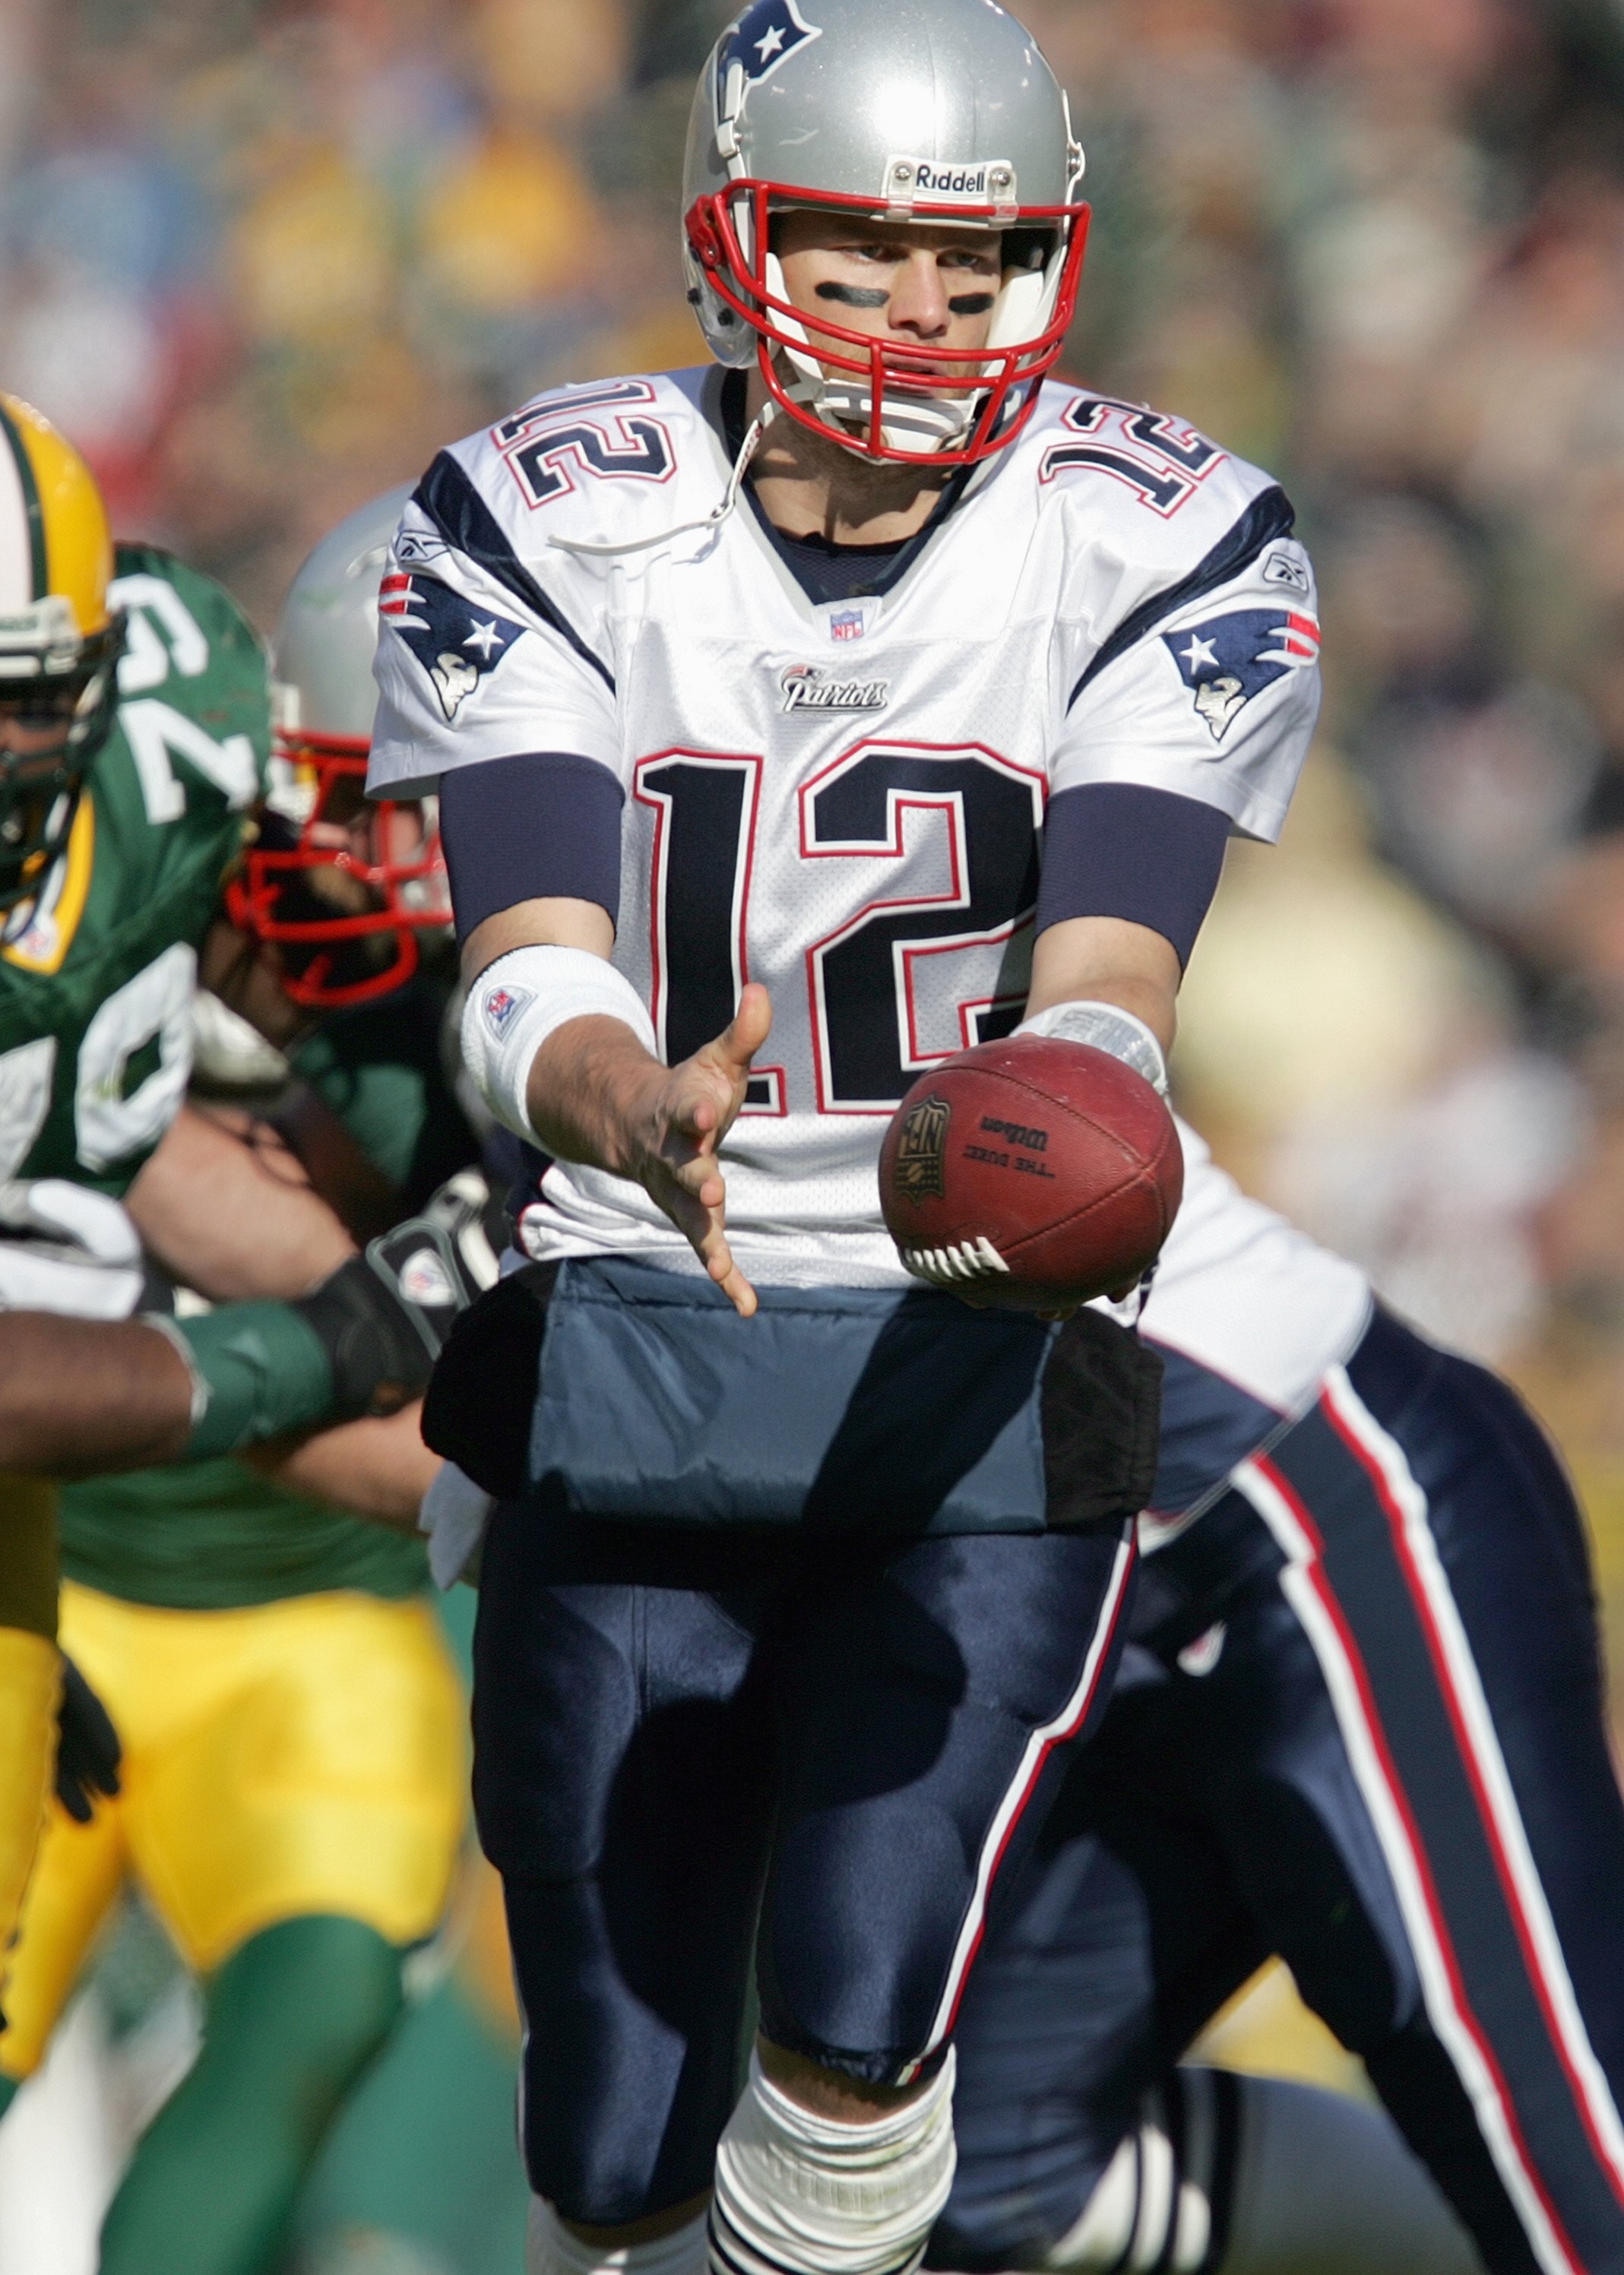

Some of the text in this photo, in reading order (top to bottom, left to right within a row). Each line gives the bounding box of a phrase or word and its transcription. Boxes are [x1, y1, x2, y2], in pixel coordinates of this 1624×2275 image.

[916, 164, 986, 192] Riddell
[490, 380, 678, 510] 12
[1038, 395, 1230, 520] 12
[781, 673, 888, 712] Patriots
[633, 738, 1049, 1116] 12
